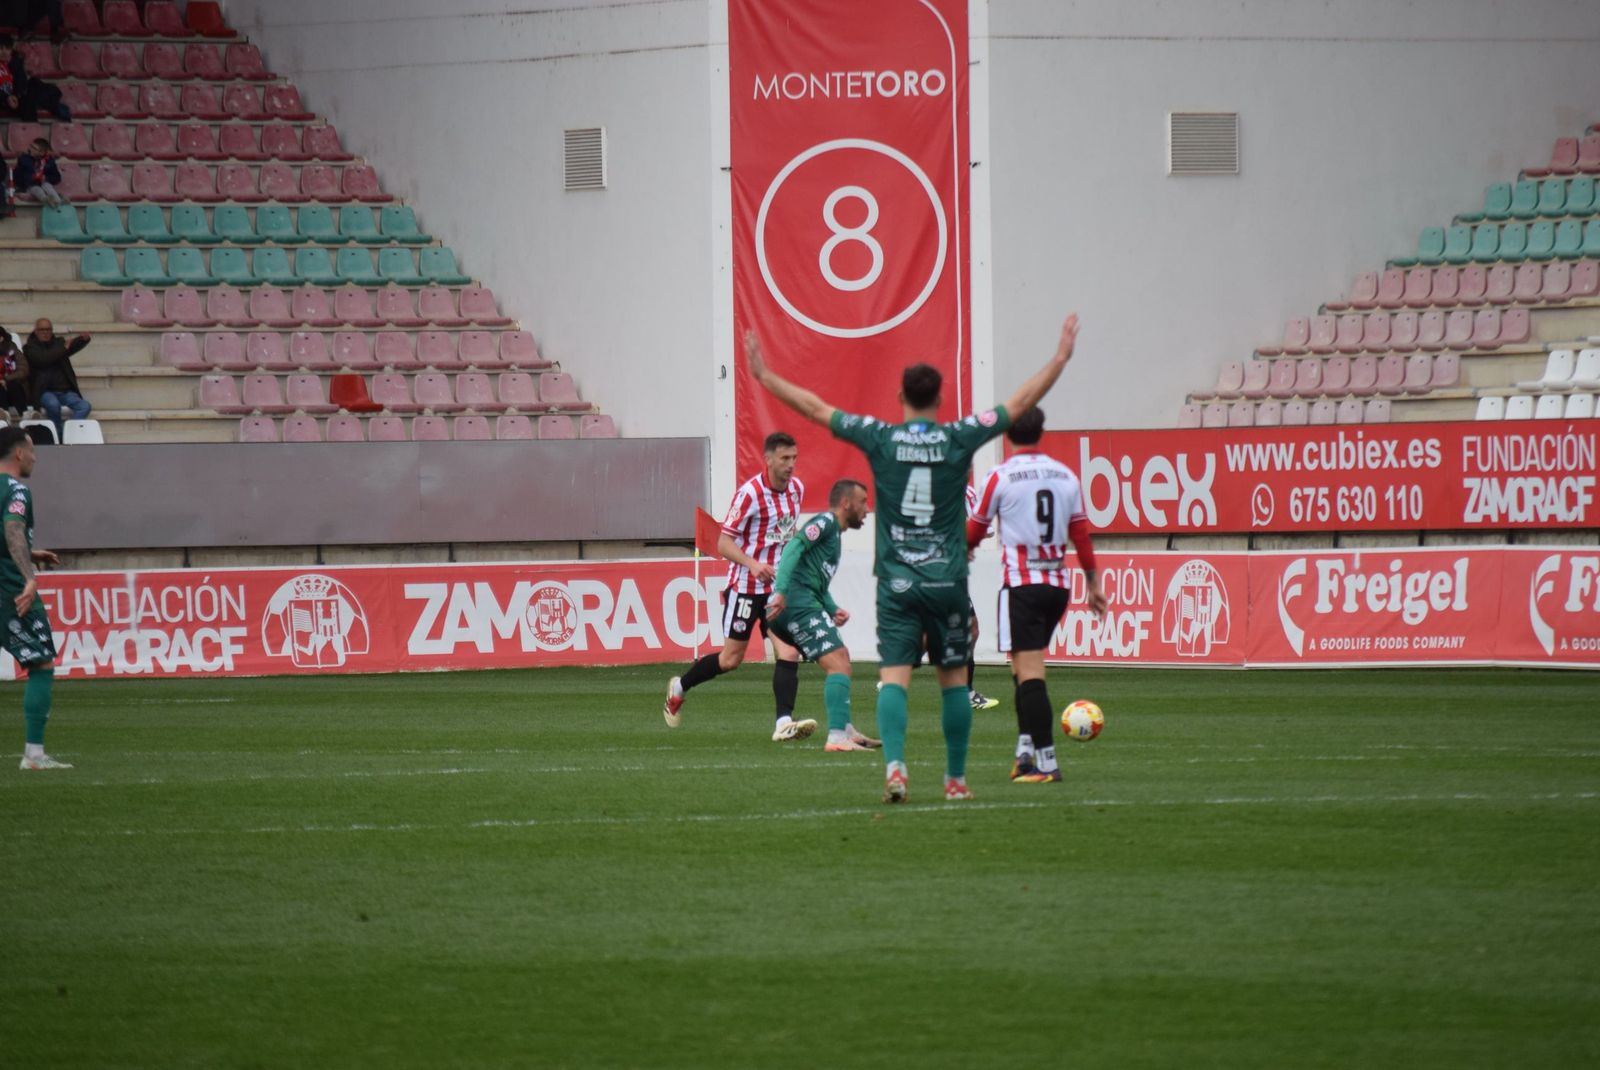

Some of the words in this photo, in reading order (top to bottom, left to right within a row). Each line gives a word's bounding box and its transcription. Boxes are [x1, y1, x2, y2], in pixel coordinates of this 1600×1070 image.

[753, 69, 946, 100] MONTETORO
[819, 185, 884, 291] 8
[1225, 431, 1442, 472] www.cubiex.es
[1463, 425, 1596, 472] FUNDACIÓN
[901, 466, 935, 526] 4
[1036, 489, 1054, 543] 9
[1289, 486, 1331, 523] 675
[1337, 485, 1377, 522] 630
[1384, 484, 1424, 521] 110
[1463, 476, 1596, 523] ZAMORACF
[737, 598, 752, 619] 16
[1314, 557, 1469, 625] Freigel
[404, 578, 662, 656] ZAMORA
[1308, 639, 1317, 650] A
[1320, 637, 1371, 650] GOODLIFE
[1374, 636, 1409, 649] FOODS
[1412, 635, 1466, 649] COMPANY
